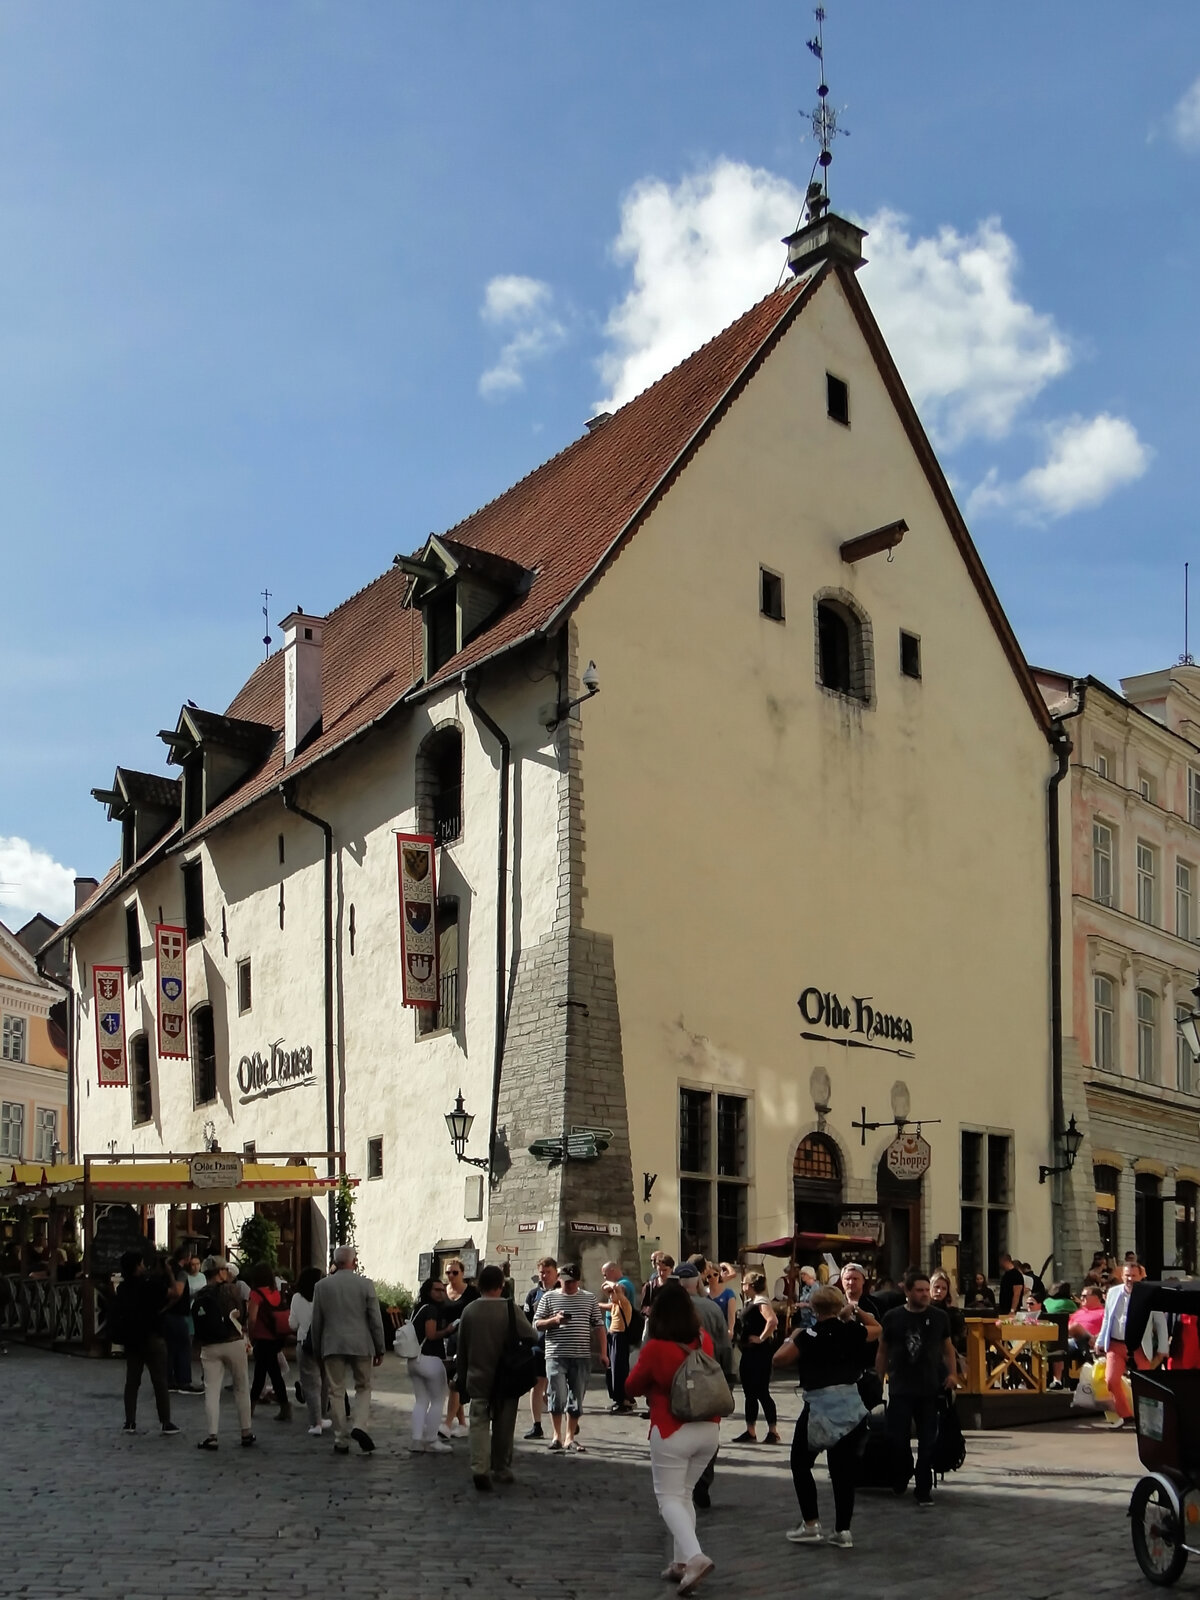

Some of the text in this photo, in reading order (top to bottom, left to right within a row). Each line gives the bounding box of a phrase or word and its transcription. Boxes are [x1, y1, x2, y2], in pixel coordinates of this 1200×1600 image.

[797, 987, 851, 1030] Olde
[237, 1051, 269, 1094] Olde
[194, 1162, 213, 1171] Olde
[890, 1149, 927, 1169] Shoppe
